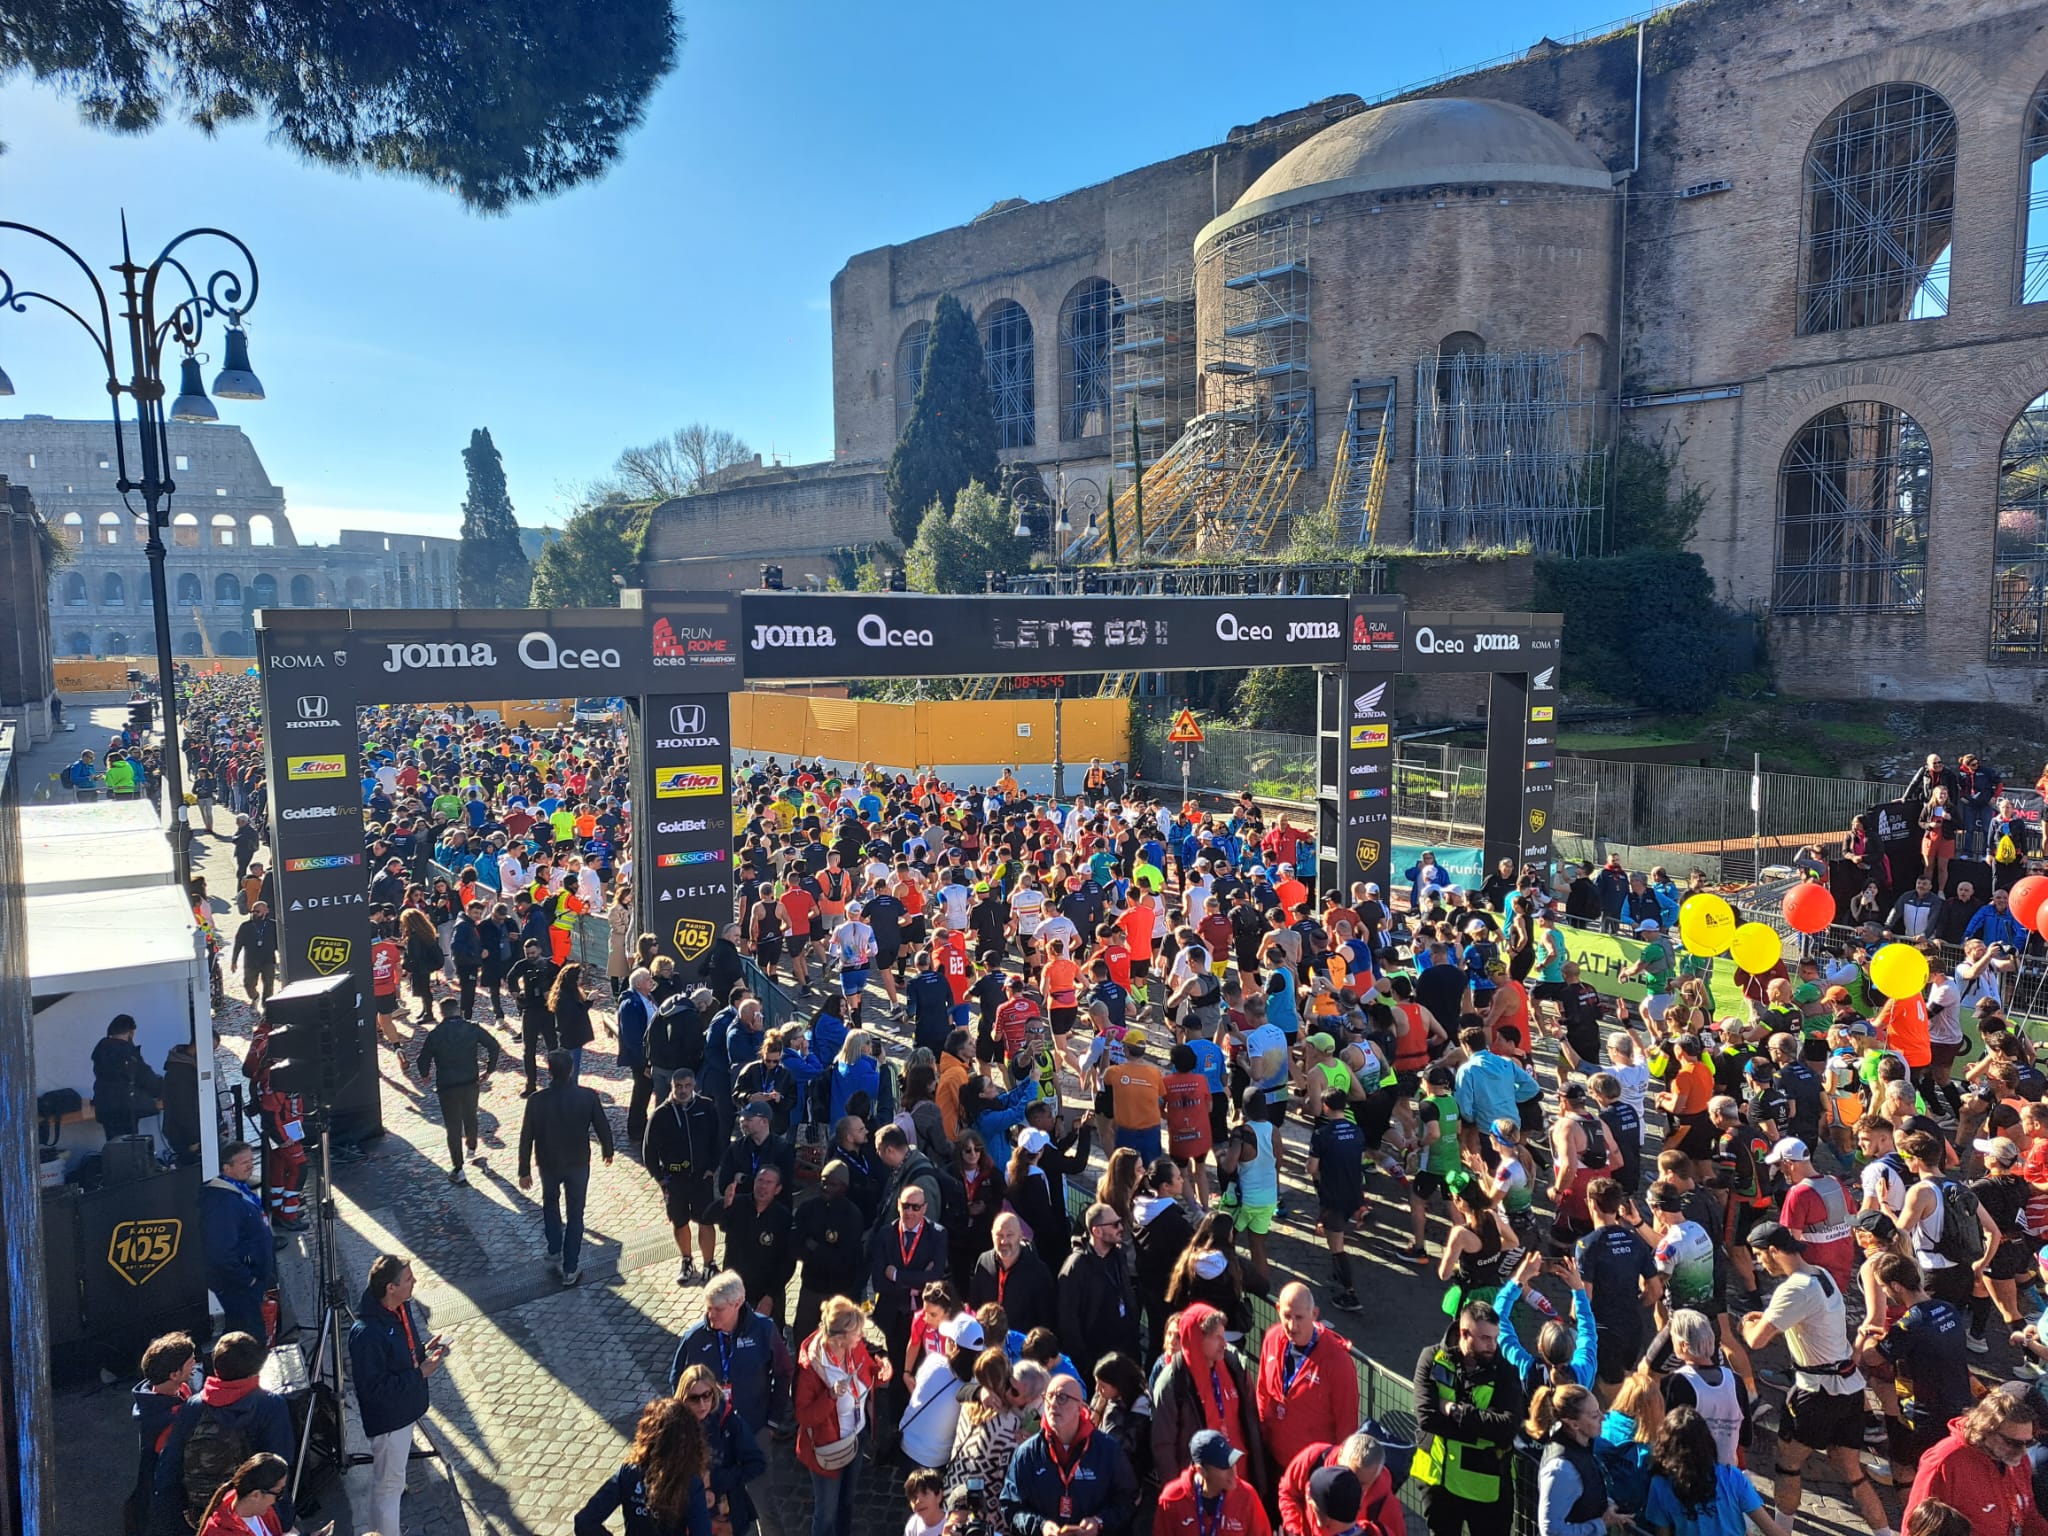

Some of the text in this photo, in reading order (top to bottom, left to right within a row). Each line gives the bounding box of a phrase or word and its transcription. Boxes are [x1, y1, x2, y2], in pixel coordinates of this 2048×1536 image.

[681, 627, 712, 640] RUN
[1368, 622, 1387, 632] RUN
[687, 639, 728, 652] ROME
[1531, 640, 1552, 649] ROMA
[270, 655, 326, 669] ROMA
[653, 657, 686, 667] acea
[1014, 675, 1065, 689] 08:45:45
[1354, 711, 1387, 719] HONDA
[286, 719, 342, 729] HONDA
[656, 736, 721, 749] HONDA
[1531, 784, 1553, 792] DELTA
[1358, 813, 1387, 824] DELTA
[1531, 815, 1543, 826] 105
[665, 851, 718, 865] MASSIGEN
[1359, 847, 1377, 860] 105
[294, 855, 353, 869] MASSIGEN
[677, 883, 727, 899] DELTA
[308, 893, 364, 908] DELTA
[678, 929, 709, 948] 105
[313, 946, 345, 963] 105
[950, 956, 964, 975] 65
[129, 1225, 167, 1235] RADIO
[117, 1234, 172, 1264] 105
